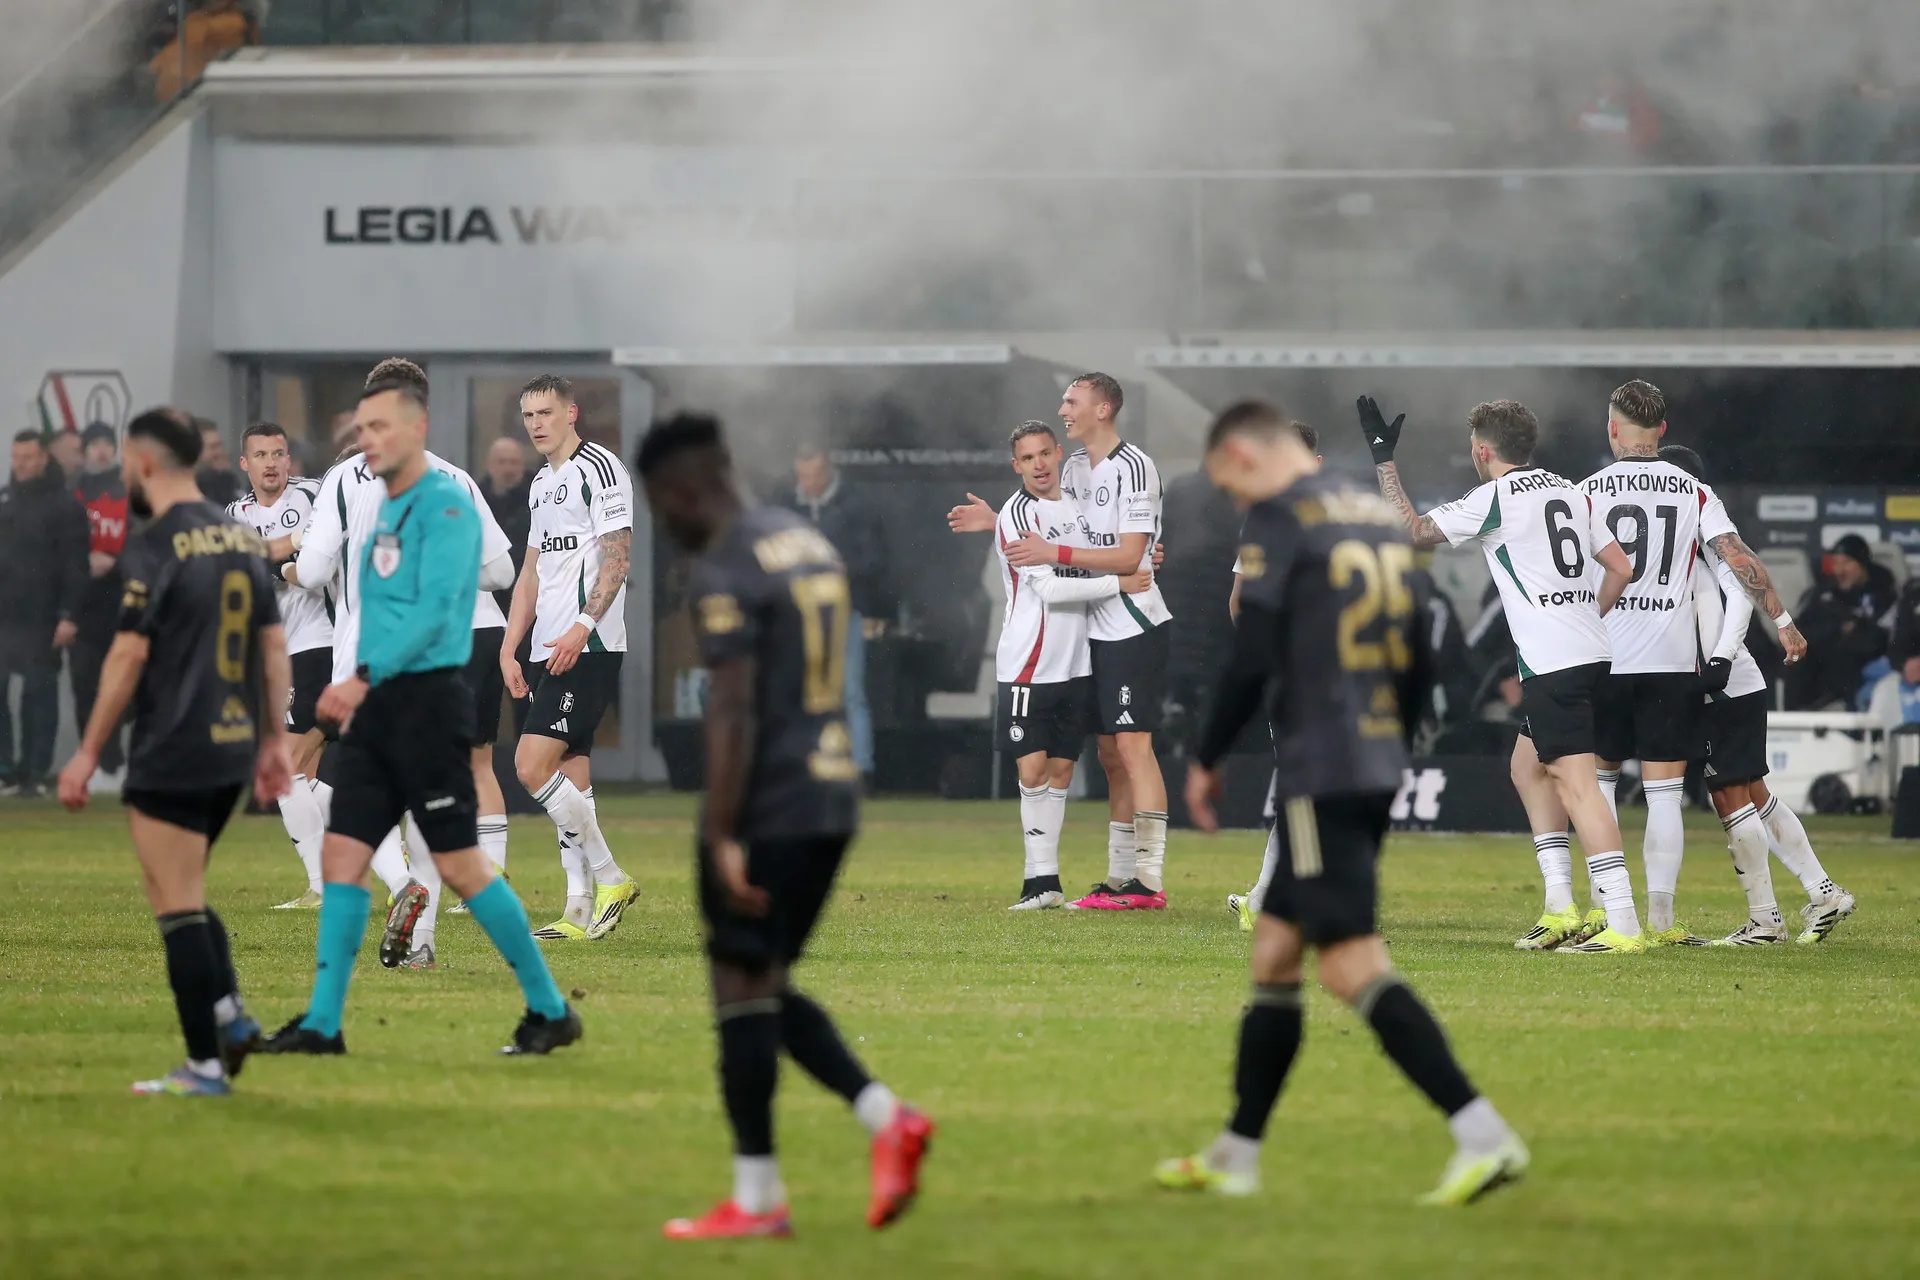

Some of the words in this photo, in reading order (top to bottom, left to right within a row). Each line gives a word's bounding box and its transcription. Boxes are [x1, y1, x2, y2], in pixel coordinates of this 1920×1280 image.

[324, 208, 501, 245] LEGIA
[1588, 473, 1694, 497] PIĄTKOWSKI
[1544, 498, 1584, 578] 6
[1605, 503, 1678, 586] 91
[1614, 596, 1676, 611] RTUNA
[216, 569, 253, 681] 8
[1011, 686, 1030, 717] 11
